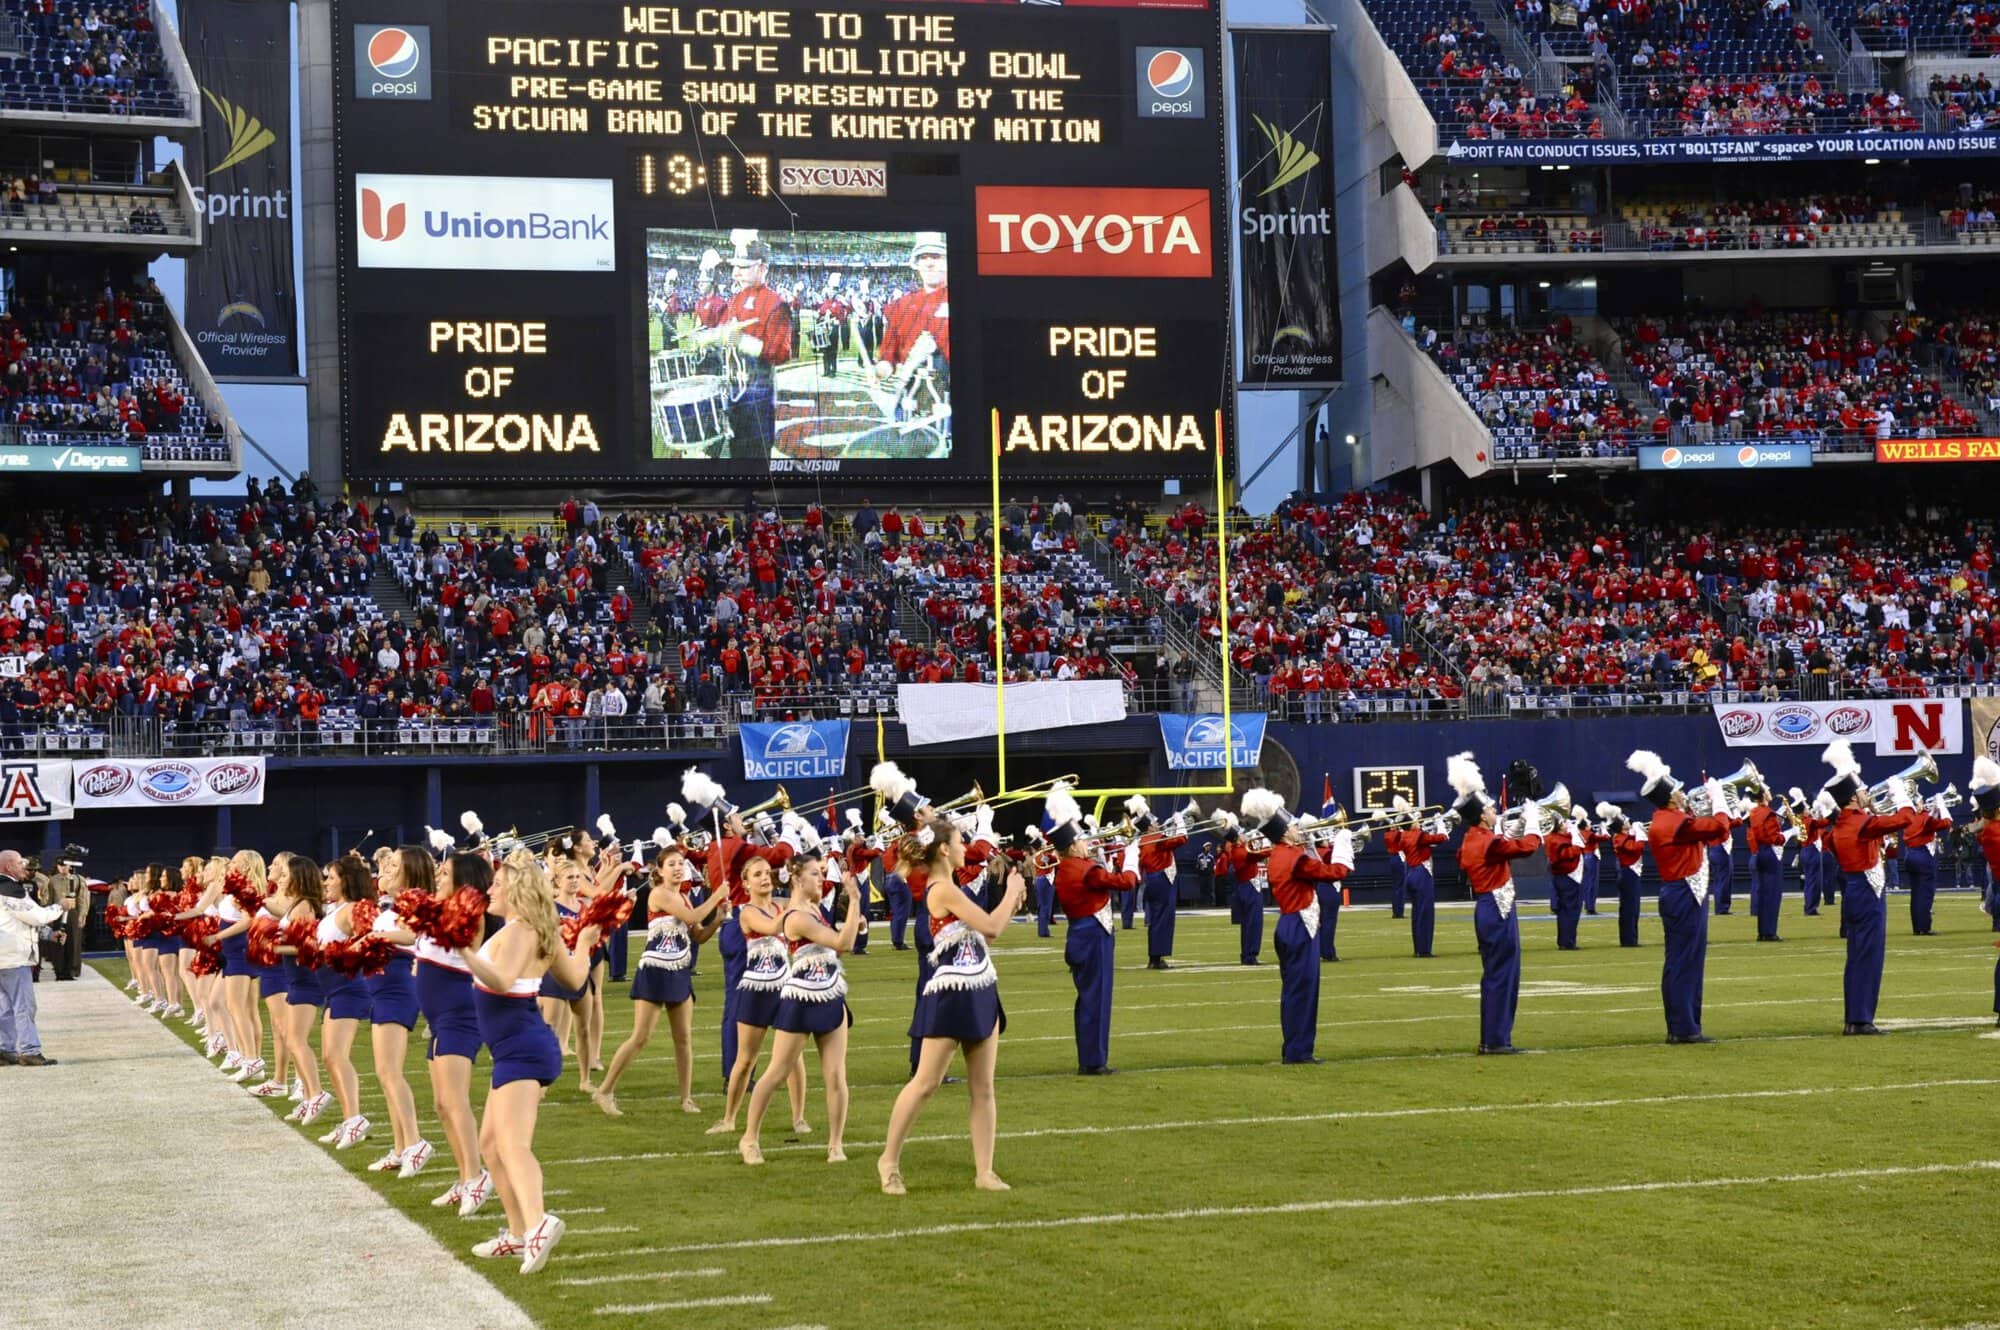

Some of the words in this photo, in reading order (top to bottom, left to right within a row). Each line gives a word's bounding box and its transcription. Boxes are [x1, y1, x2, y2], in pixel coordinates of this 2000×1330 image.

[623, 6, 791, 38] WELCOME
[815, 13, 862, 40] TO
[886, 14, 955, 42] THE
[487, 37, 659, 69] PACIFIC
[683, 42, 779, 73] LIFE
[803, 47, 966, 77] HOLIDAY
[989, 52, 1081, 80] BOWL
[371, 81, 417, 96] pepsi
[511, 76, 663, 101] PRE-GAME
[682, 79, 756, 104] SHOW
[775, 84, 939, 109] PRESENTED
[957, 89, 992, 109] BY
[1011, 89, 1064, 111] THE
[1151, 100, 1192, 115] pepsi
[473, 105, 588, 132] SYCUAN
[607, 109, 682, 134] BAND
[702, 111, 738, 136] OF
[758, 113, 812, 137] THE
[830, 114, 976, 141] KUMEYAAY
[994, 118, 1100, 143] NATION
[1456, 145, 1494, 158] PORT
[1498, 146, 1523, 157] FAN
[1527, 145, 1588, 157] CONDUCT
[1592, 144, 1640, 158] ISSUES,
[1643, 143, 1676, 156] TEXT
[1816, 139, 1853, 152] YOUR
[1857, 138, 1926, 151] LOCATION
[1928, 138, 1955, 150] AND
[1959, 137, 1996, 149] ISSUE
[781, 166, 885, 190] SYCUAN
[424, 210, 609, 241] UnionBank
[988, 213, 1201, 255] TOYOTA
[1242, 207, 1331, 242] Sprint
[197, 331, 238, 343] Official
[240, 332, 286, 344] Wireless
[222, 344, 269, 356] Provider
[430, 322, 547, 353] PRIDE
[1049, 326, 1156, 357] PRIDE
[1252, 354, 1288, 365] Official
[1290, 353, 1333, 365] Wireless
[1272, 365, 1314, 375] Provider
[464, 366, 514, 398] OF
[1080, 370, 1127, 400] OF
[380, 413, 600, 452] ARIZONA
[1005, 415, 1207, 452] ARIZONA
[69, 451, 129, 470] Degree
[1683, 451, 1715, 464] pepsi
[1759, 450, 1791, 462] pepsi
[1881, 442, 1962, 459] WELLS
[769, 459, 794, 472] BOLT
[1892, 703, 1945, 751] N
[98, 770, 114, 781] Dr
[215, 772, 250, 791] Pepper
[225, 767, 241, 779] Dr
[744, 759, 811, 780] PACIFIC
[0, 763, 51, 818] A
[89, 773, 122, 793] Pepper
[1367, 770, 1414, 808] 25
[952, 940, 980, 967] A
